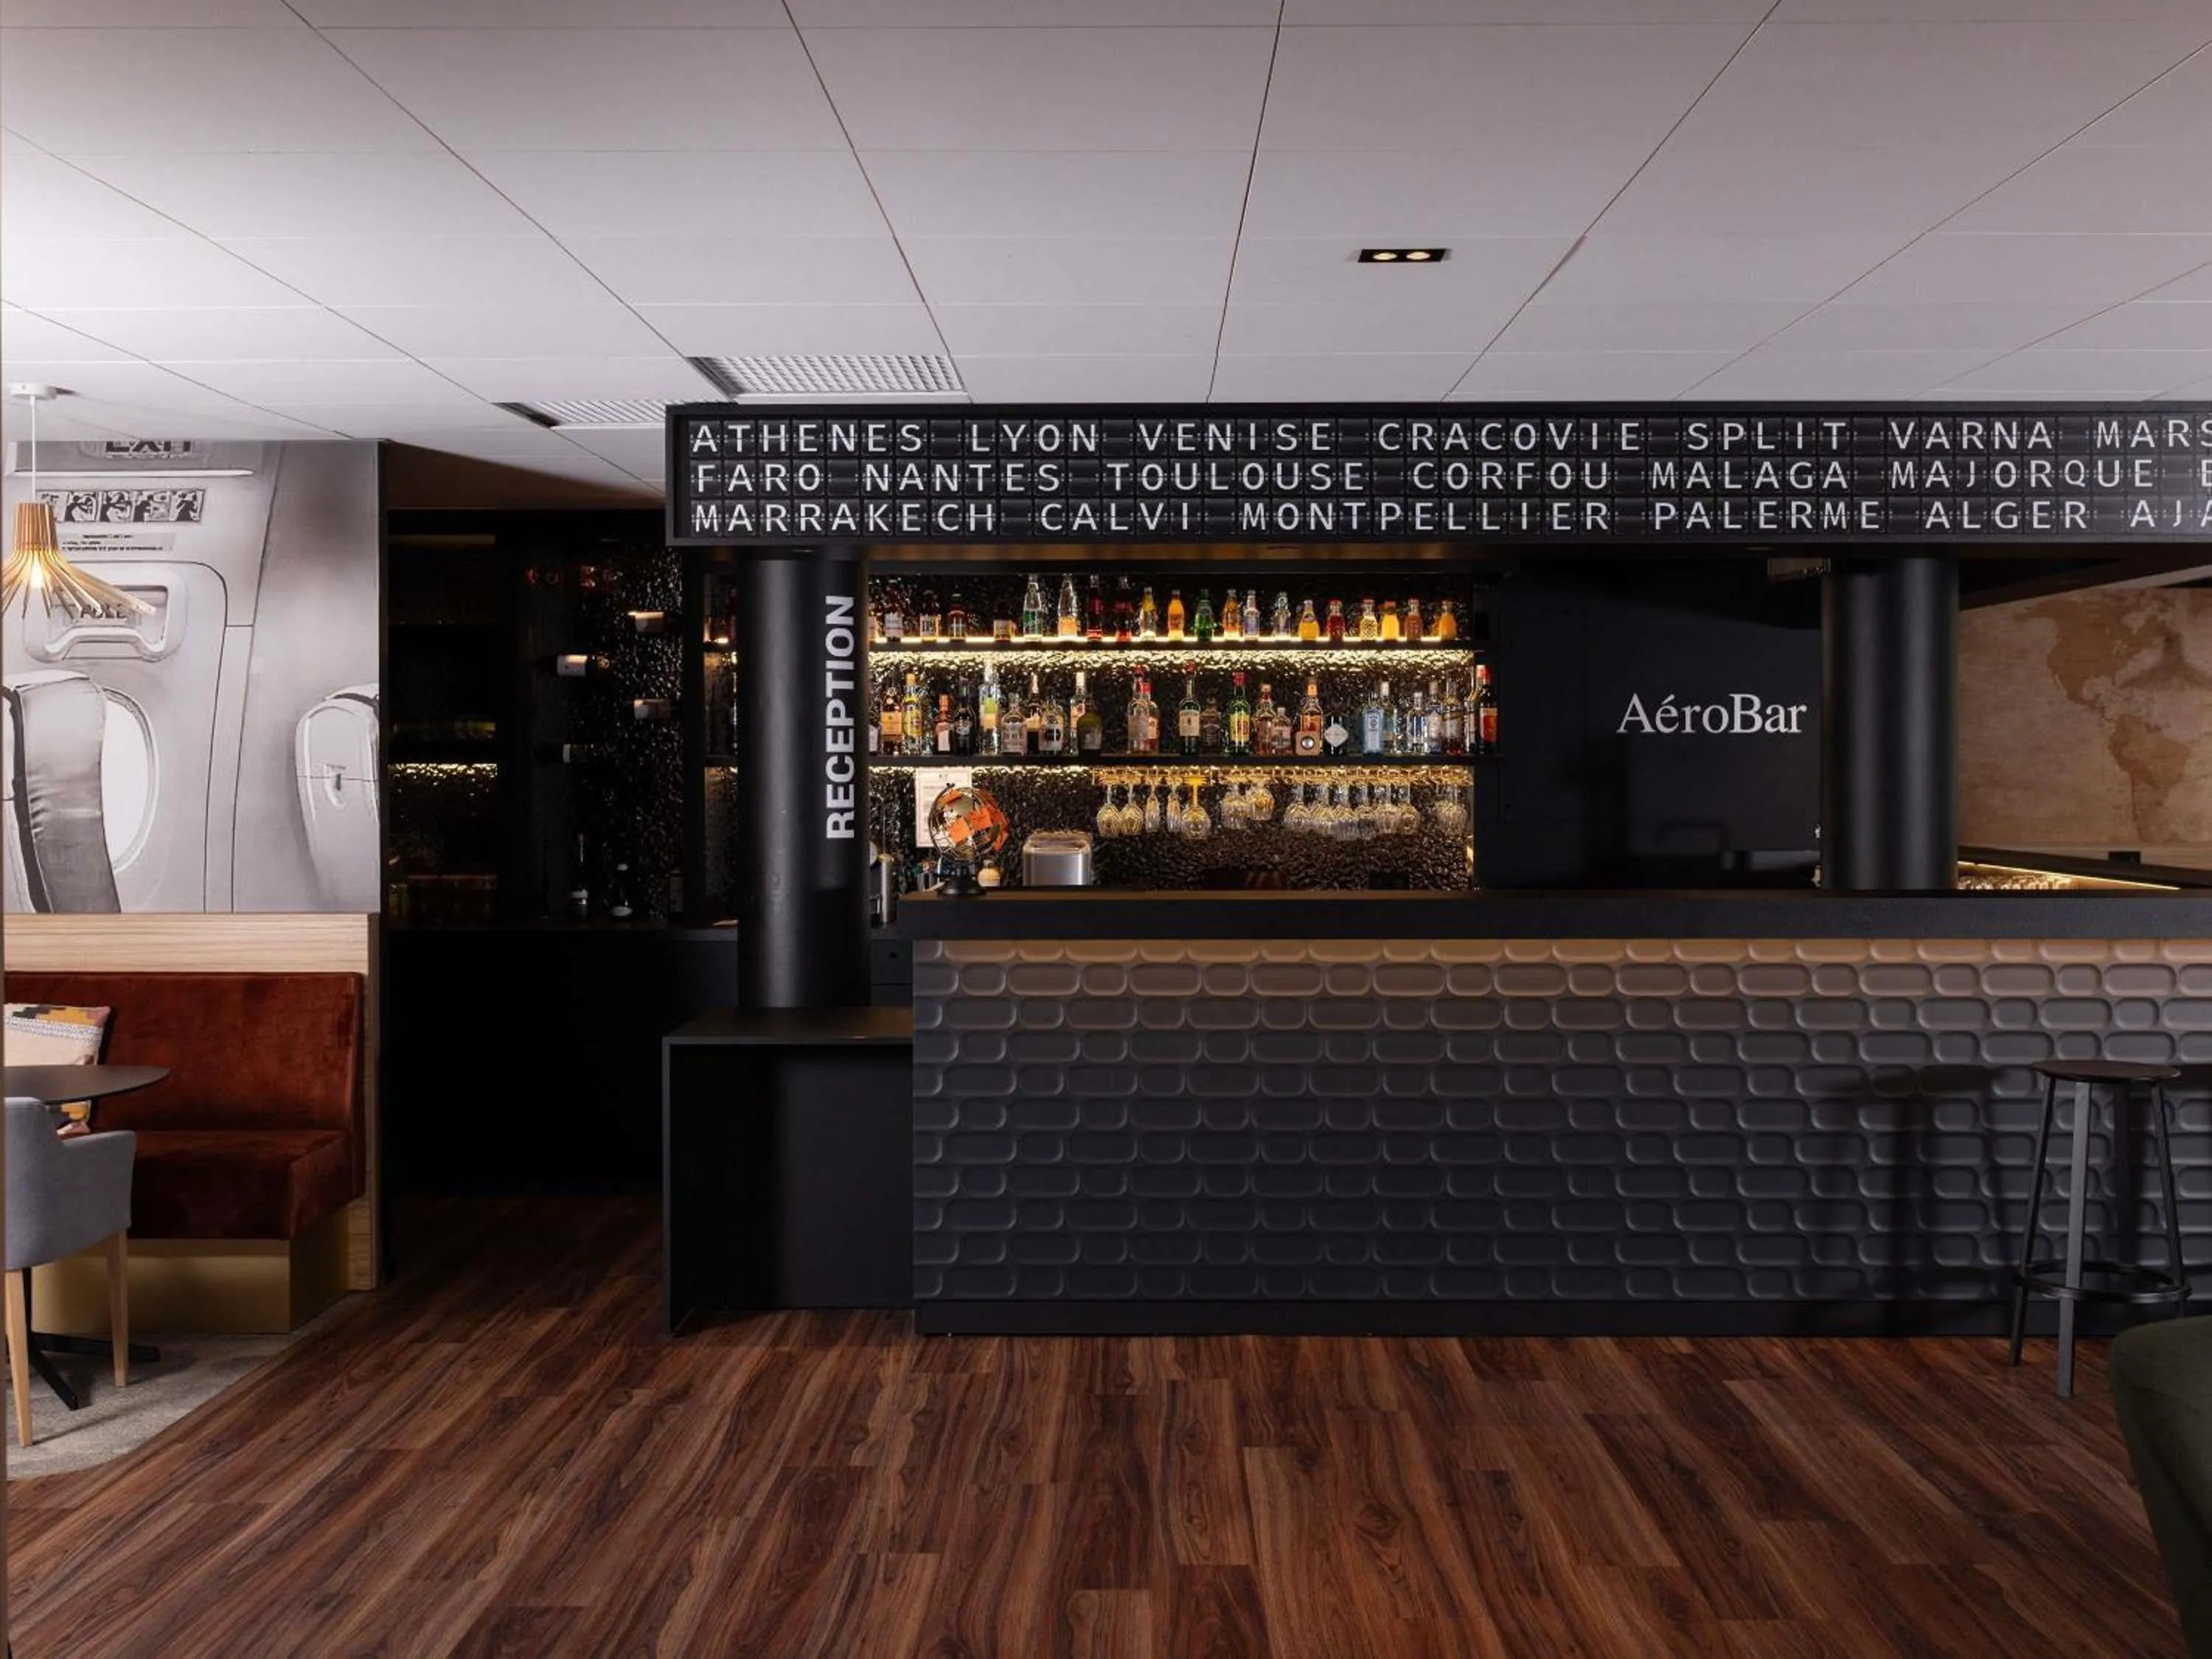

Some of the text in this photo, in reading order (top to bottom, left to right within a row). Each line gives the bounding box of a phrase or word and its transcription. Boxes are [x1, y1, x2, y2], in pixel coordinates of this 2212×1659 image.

[692, 419, 2212, 453] ATHENES LYON VENISE CRACOVIE SPLIT VARNA MARS
[698, 463, 821, 493] FARO
[866, 462, 1060, 492] NANTES
[1107, 462, 1363, 490] TOULOUSE
[1413, 462, 1607, 490] CORFOU
[1652, 461, 1848, 489] MALAGA
[1891, 459, 2153, 489] MAJORQUE
[695, 503, 992, 532] MARRAKECH
[1040, 502, 1188, 531] CALVI
[1242, 502, 1608, 530] MONTPELLIER
[1655, 501, 1879, 530] PALERME
[1925, 501, 2087, 529] ALGER
[825, 595, 855, 838] RECEPTION
[1616, 693, 1807, 734] AéroBar
